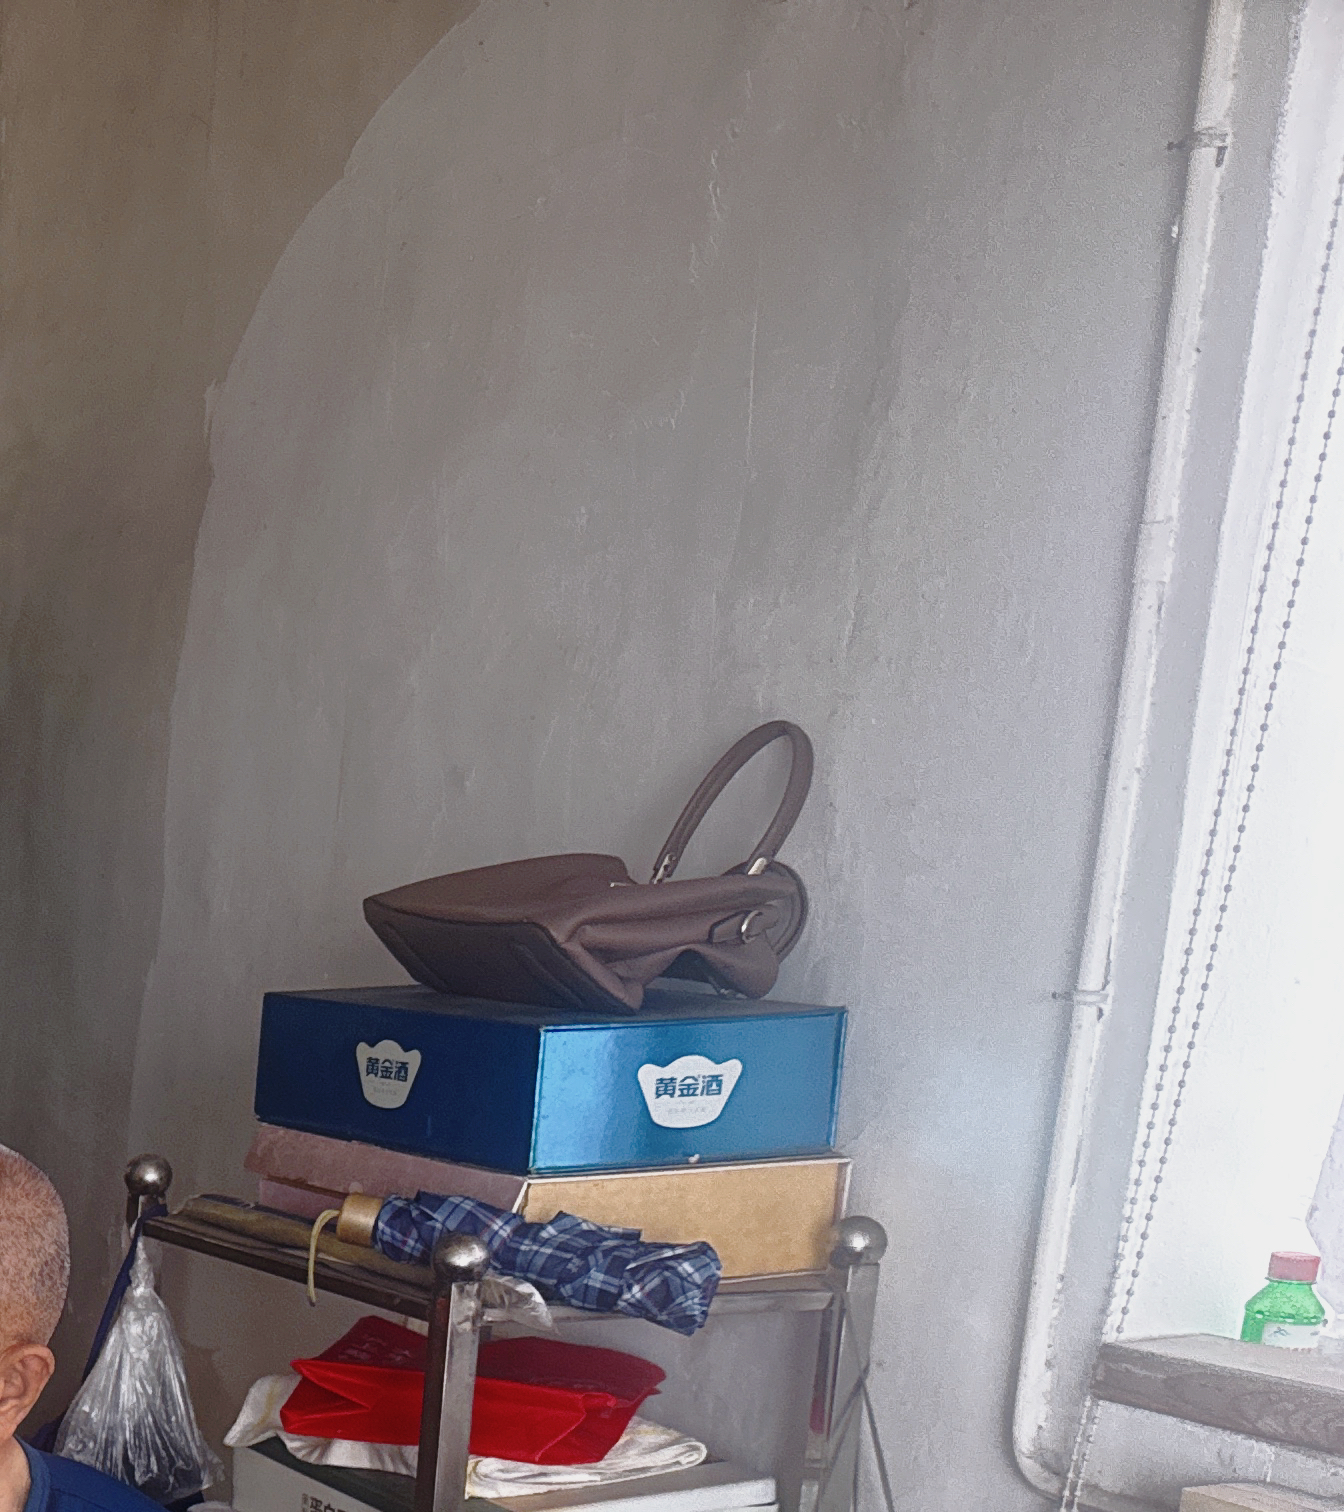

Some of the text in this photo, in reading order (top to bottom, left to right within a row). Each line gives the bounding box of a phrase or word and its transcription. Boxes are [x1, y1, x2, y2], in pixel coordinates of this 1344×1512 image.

[365, 1056, 409, 1083] 黄金酒
[654, 1073, 724, 1099] 黄金酒
